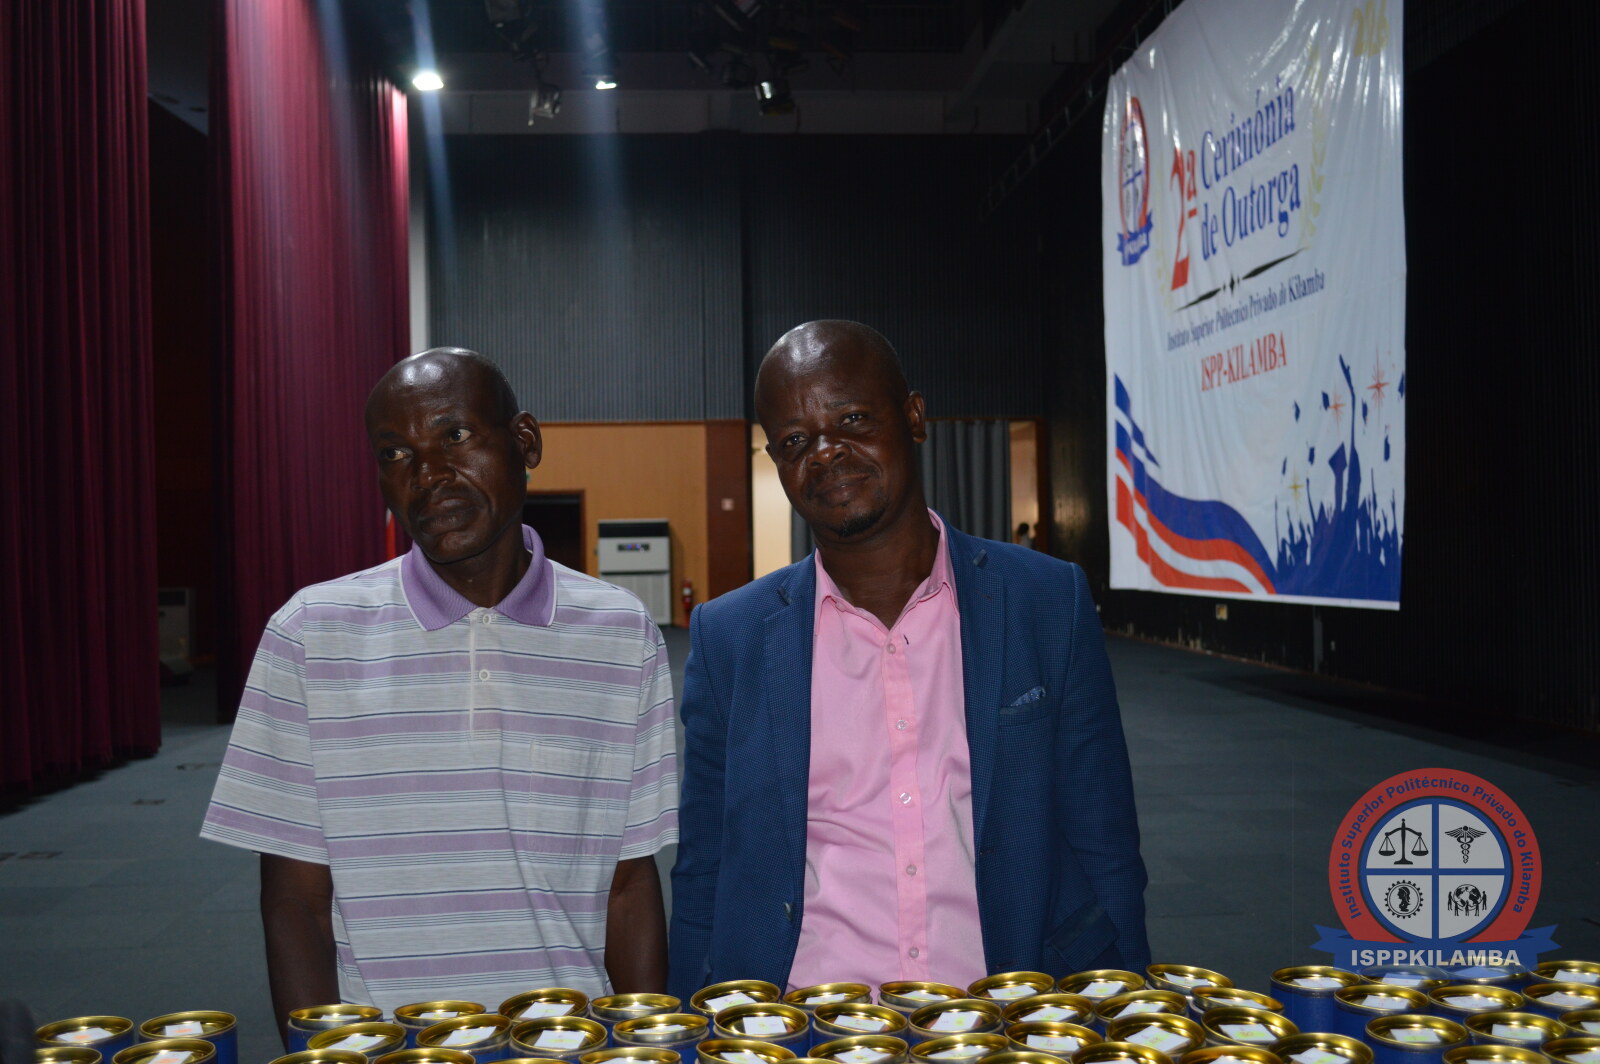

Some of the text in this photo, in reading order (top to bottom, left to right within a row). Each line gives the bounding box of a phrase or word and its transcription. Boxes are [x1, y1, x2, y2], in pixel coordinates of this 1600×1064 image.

[1200, 74, 1296, 189] Cerimónia
[1201, 163, 1301, 261] de Outorga
[1167, 331, 1190, 351] Instituto
[1190, 317, 1215, 346] Superior
[1215, 304, 1249, 333] Politécnico
[1249, 287, 1278, 319] Privado
[1288, 268, 1325, 302] Kilamba
[1201, 331, 1287, 392] ISPP-KILAMBA
